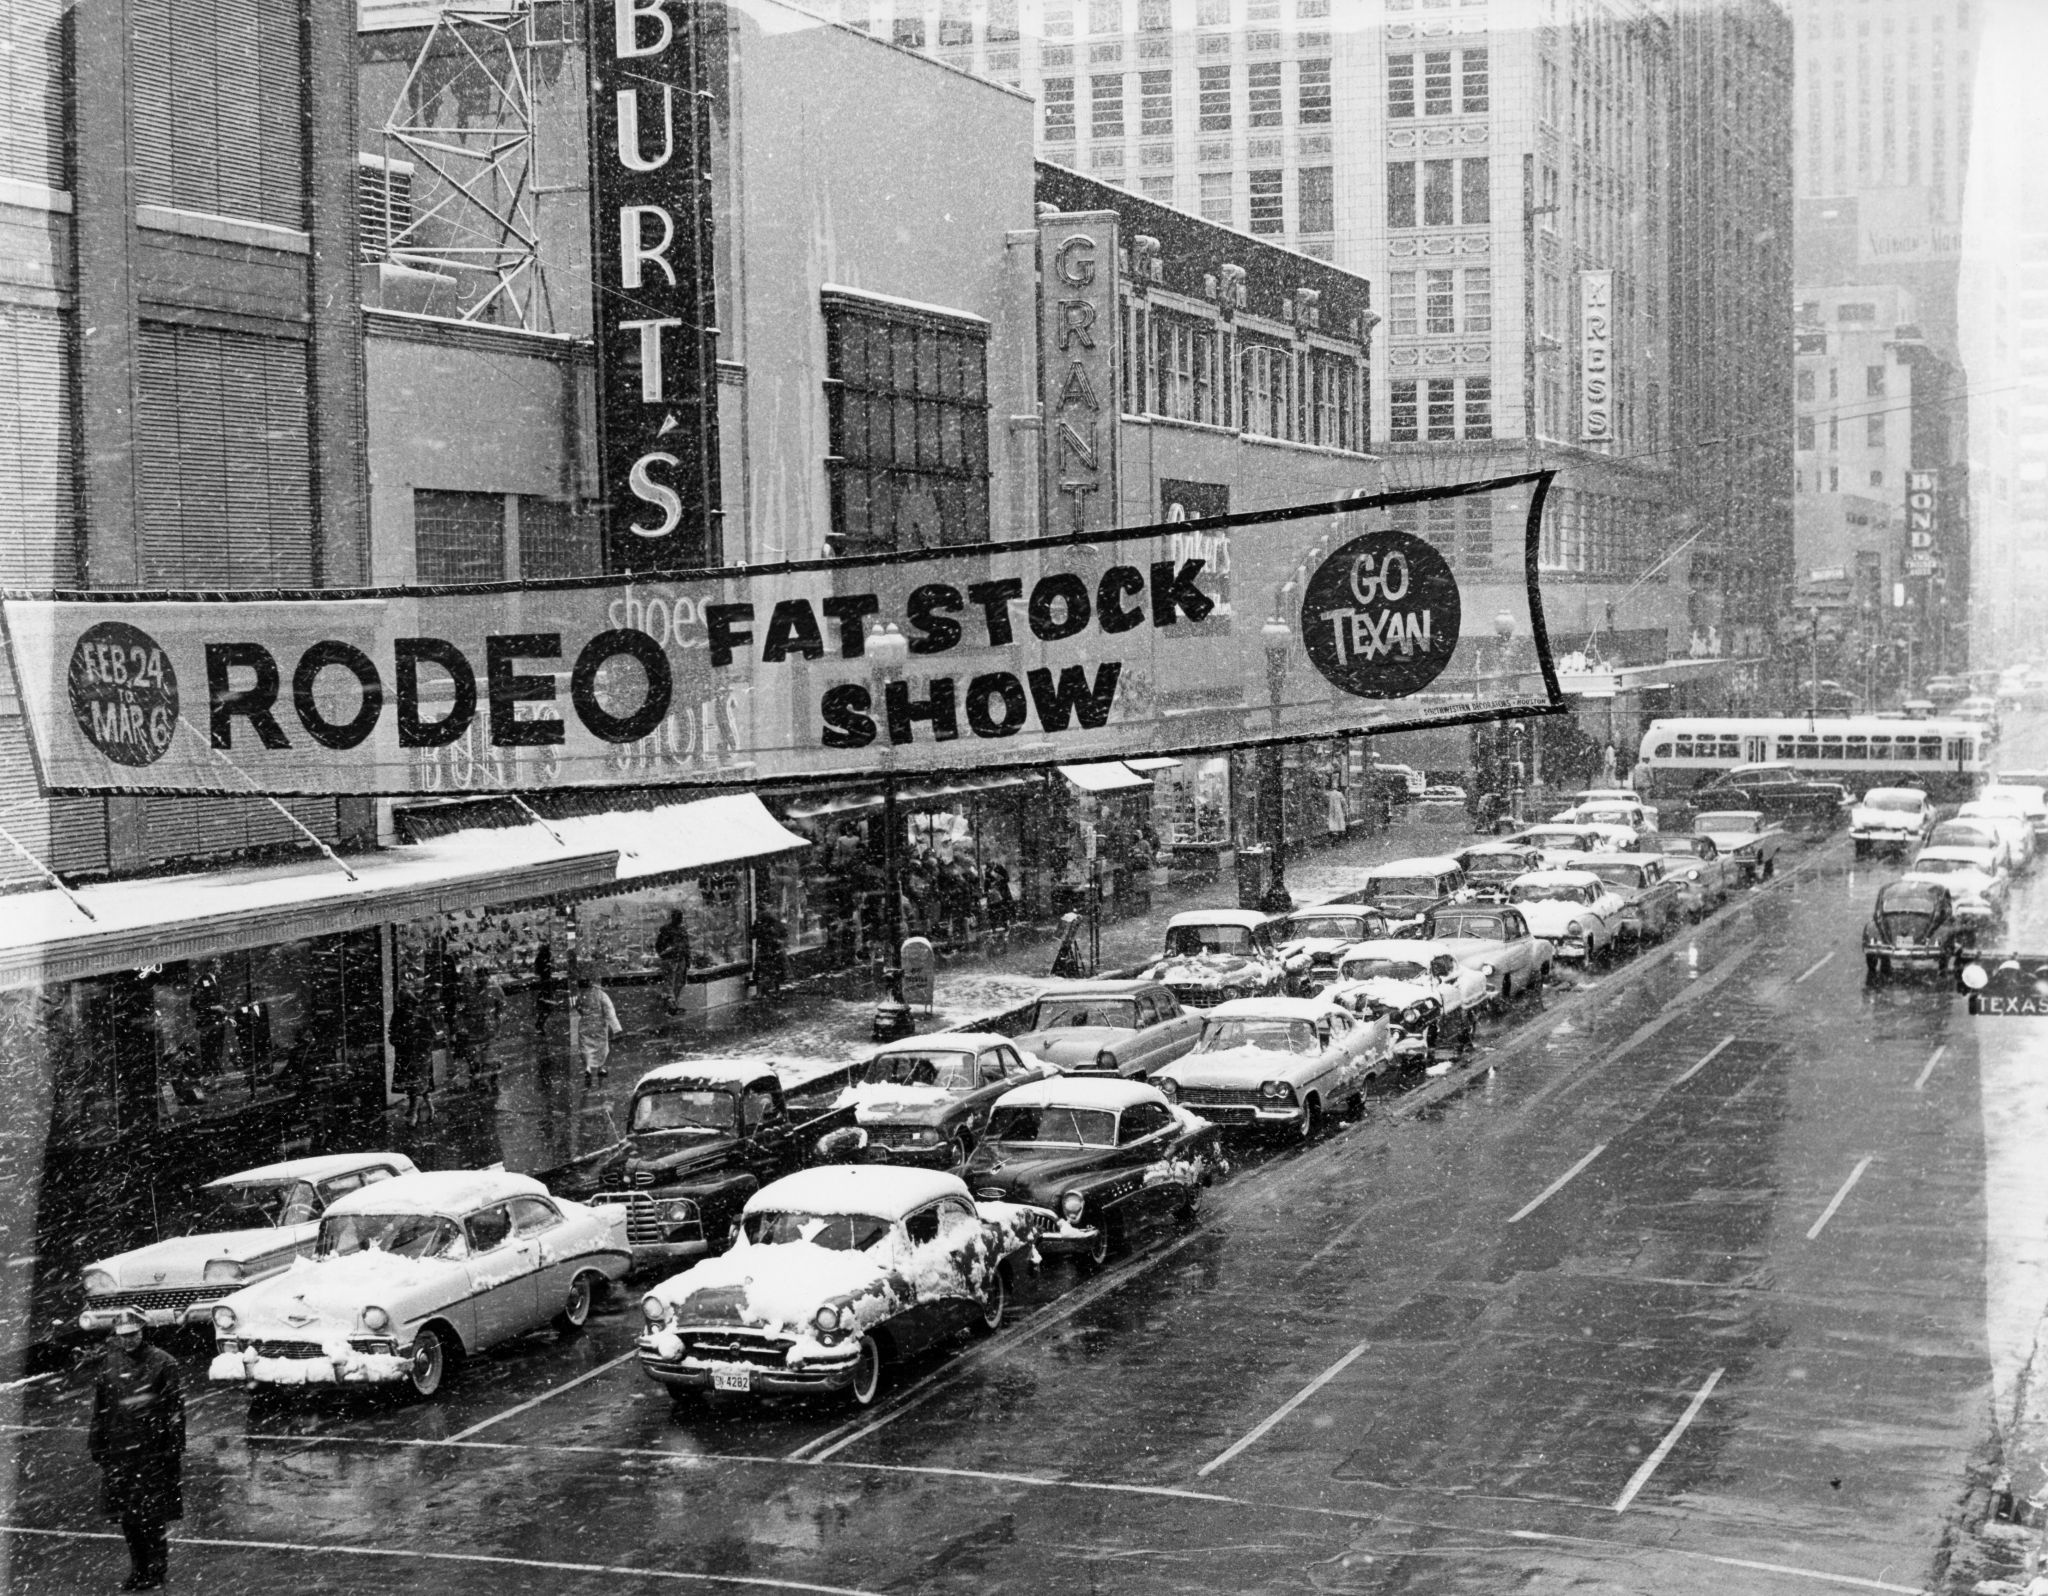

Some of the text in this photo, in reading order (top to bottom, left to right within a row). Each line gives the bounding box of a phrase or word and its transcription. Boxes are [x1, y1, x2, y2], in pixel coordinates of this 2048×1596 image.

[616, 0, 683, 538] BURT'S
[1910, 474, 1932, 548] BOND
[705, 558, 1215, 667] FAT STOCK
[1350, 550, 1409, 605] GO
[1320, 607, 1431, 666] TEXAN
[90, 700, 169, 748] MAR 6
[203, 628, 672, 750] RODEO
[820, 662, 1122, 749] SHOW
[1977, 995, 2048, 1013] TEXAS
